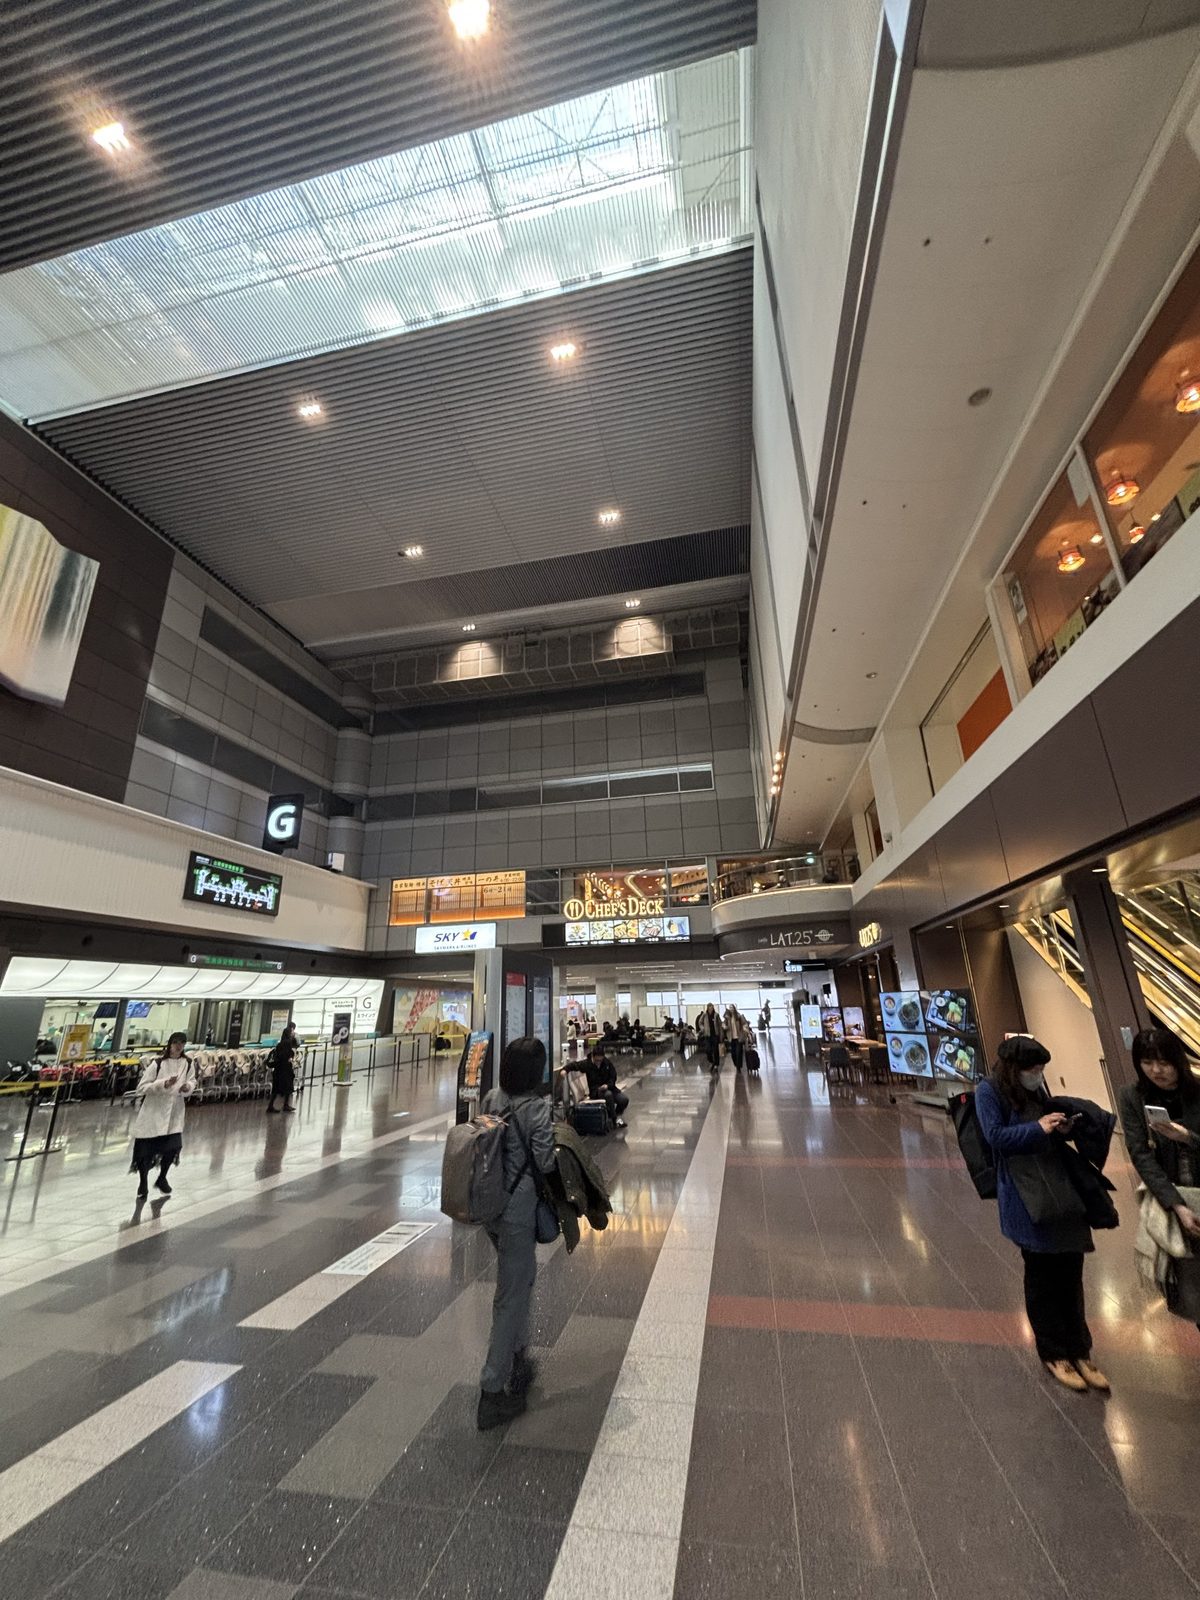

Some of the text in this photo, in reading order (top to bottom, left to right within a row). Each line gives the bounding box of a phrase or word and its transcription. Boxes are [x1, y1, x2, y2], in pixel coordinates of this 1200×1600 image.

[267, 804, 296, 839] G
[585, 897, 664, 918] CHEF'S DECK
[434, 932, 460, 943] SKY
[362, 996, 372, 1009] G
